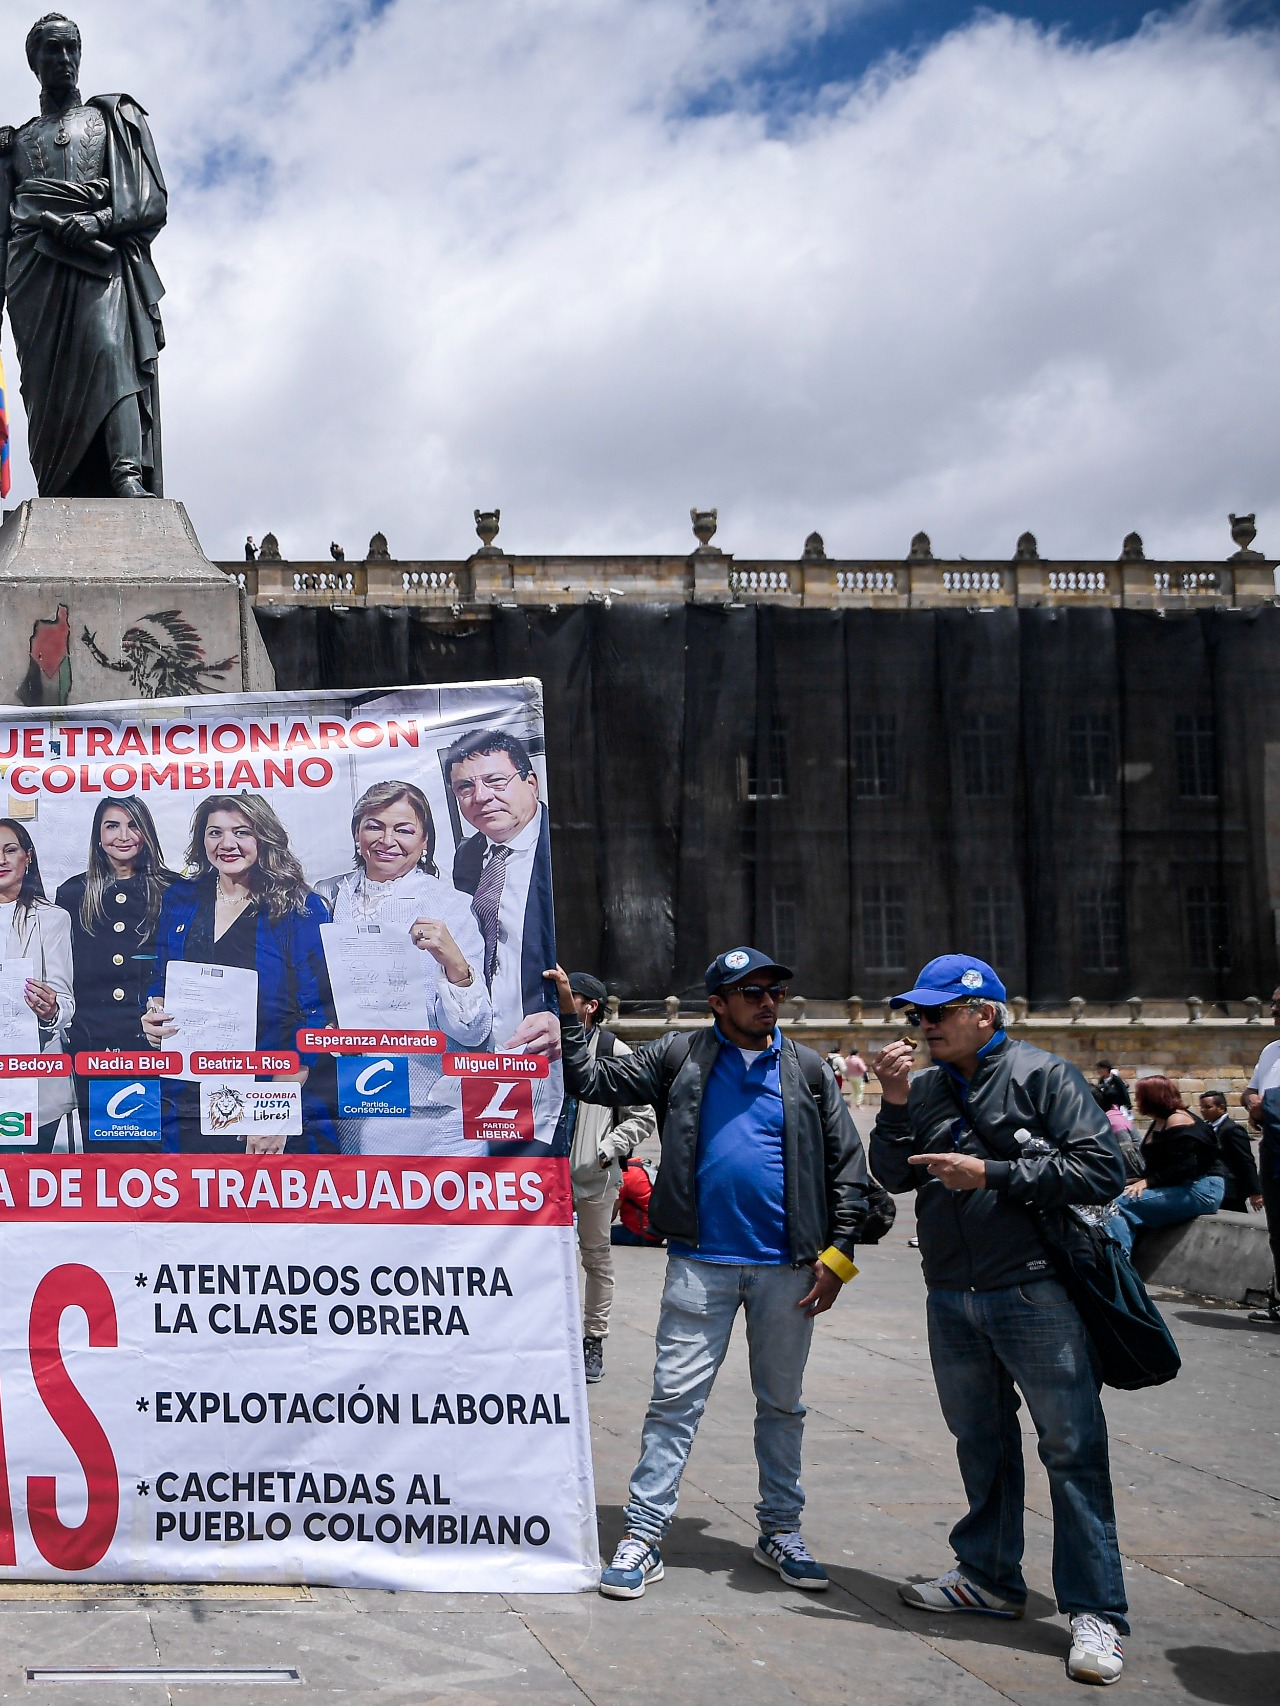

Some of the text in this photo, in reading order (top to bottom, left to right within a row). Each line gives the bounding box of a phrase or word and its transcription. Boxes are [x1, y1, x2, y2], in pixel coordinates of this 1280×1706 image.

[59, 719, 420, 757] TRAICIONARON
[10, 757, 334, 795] COLOMBIANO
[305, 1034, 437, 1046] Esperanza Andrade
[9, 1059, 64, 1073] Bedoya
[88, 1057, 134, 1070] Nadia
[198, 1057, 290, 1070] Beatriz L. Ríos
[454, 1057, 537, 1073] Miguel Pinto
[253, 1110, 290, 1121] Libres!
[344, 1106, 406, 1114] Conservador
[94, 1129, 157, 1137] Conservador
[476, 1130, 523, 1139] LIBERAL
[28, 1169, 81, 1208] DE
[96, 1168, 180, 1208] LOS
[192, 1169, 544, 1212] TRABAJADORES
[370, 1266, 513, 1297] CONTRA
[154, 1303, 470, 1336] LA CLASE OBRERA
[412, 1394, 570, 1424] LABORAL
[406, 1474, 451, 1505] AL
[156, 1511, 550, 1546] PUEBLO COLOMBIANO
